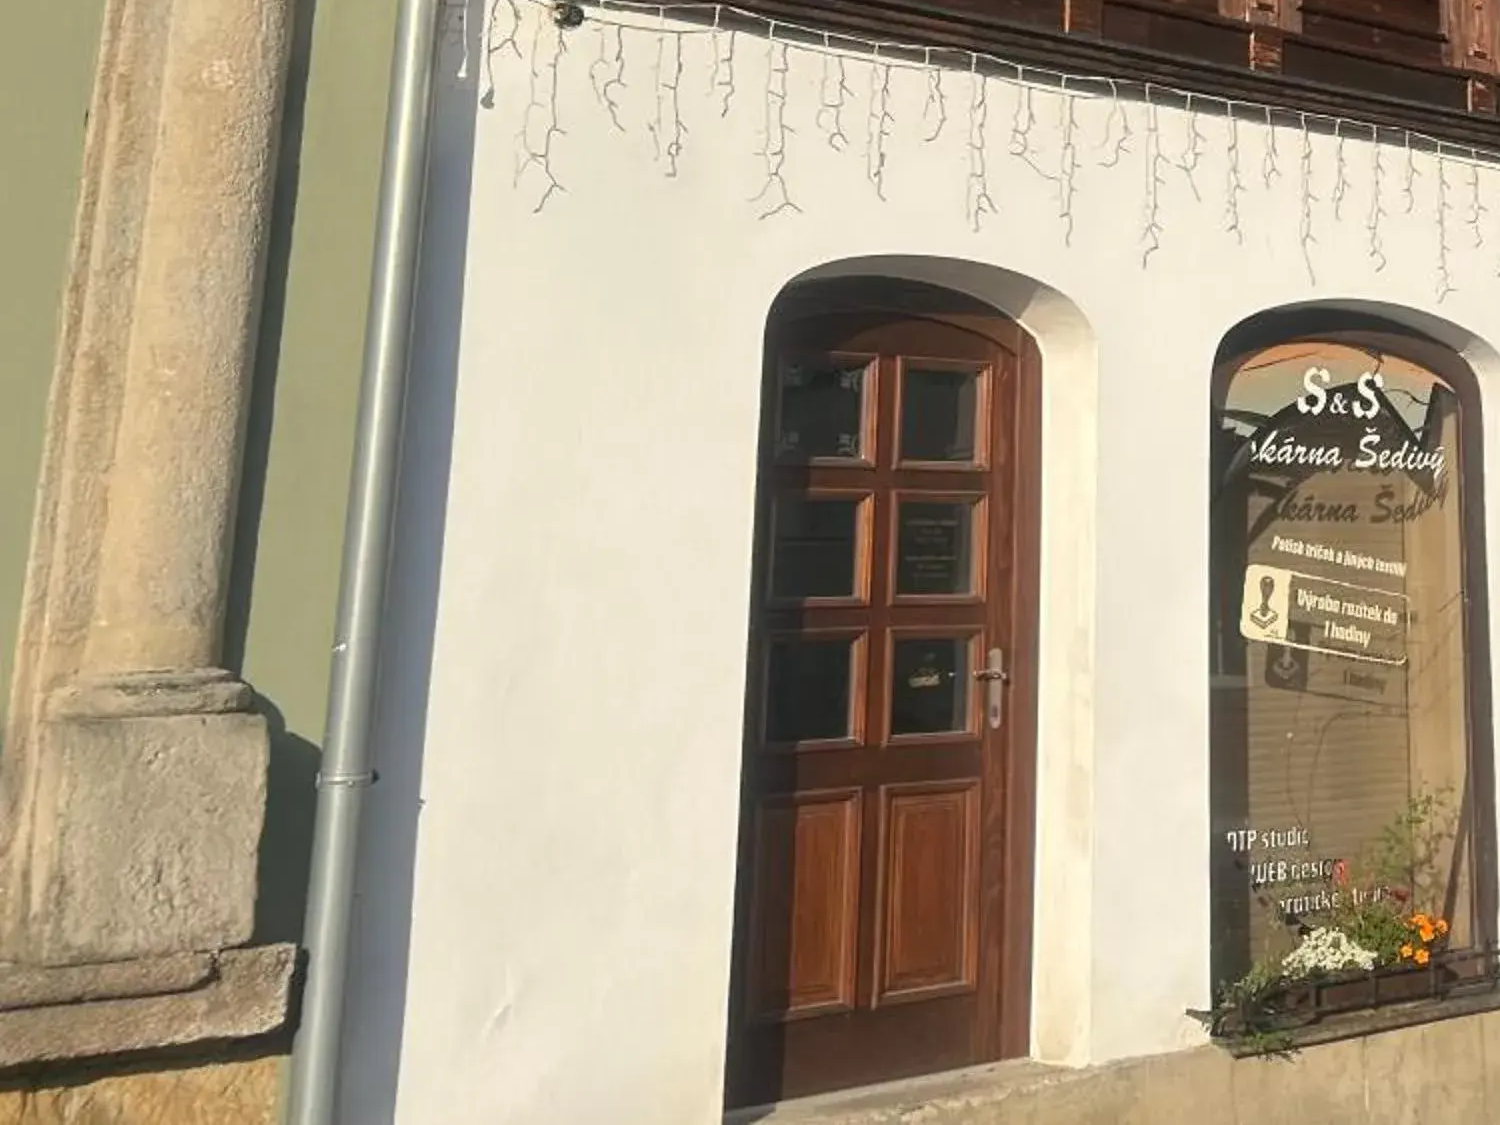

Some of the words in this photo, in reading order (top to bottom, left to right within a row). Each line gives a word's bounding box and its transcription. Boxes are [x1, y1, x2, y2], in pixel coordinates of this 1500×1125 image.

[1355, 427, 1446, 479] Šedivý
[1297, 588, 1340, 613] Výroba
[1331, 621, 1371, 648] hodiny
